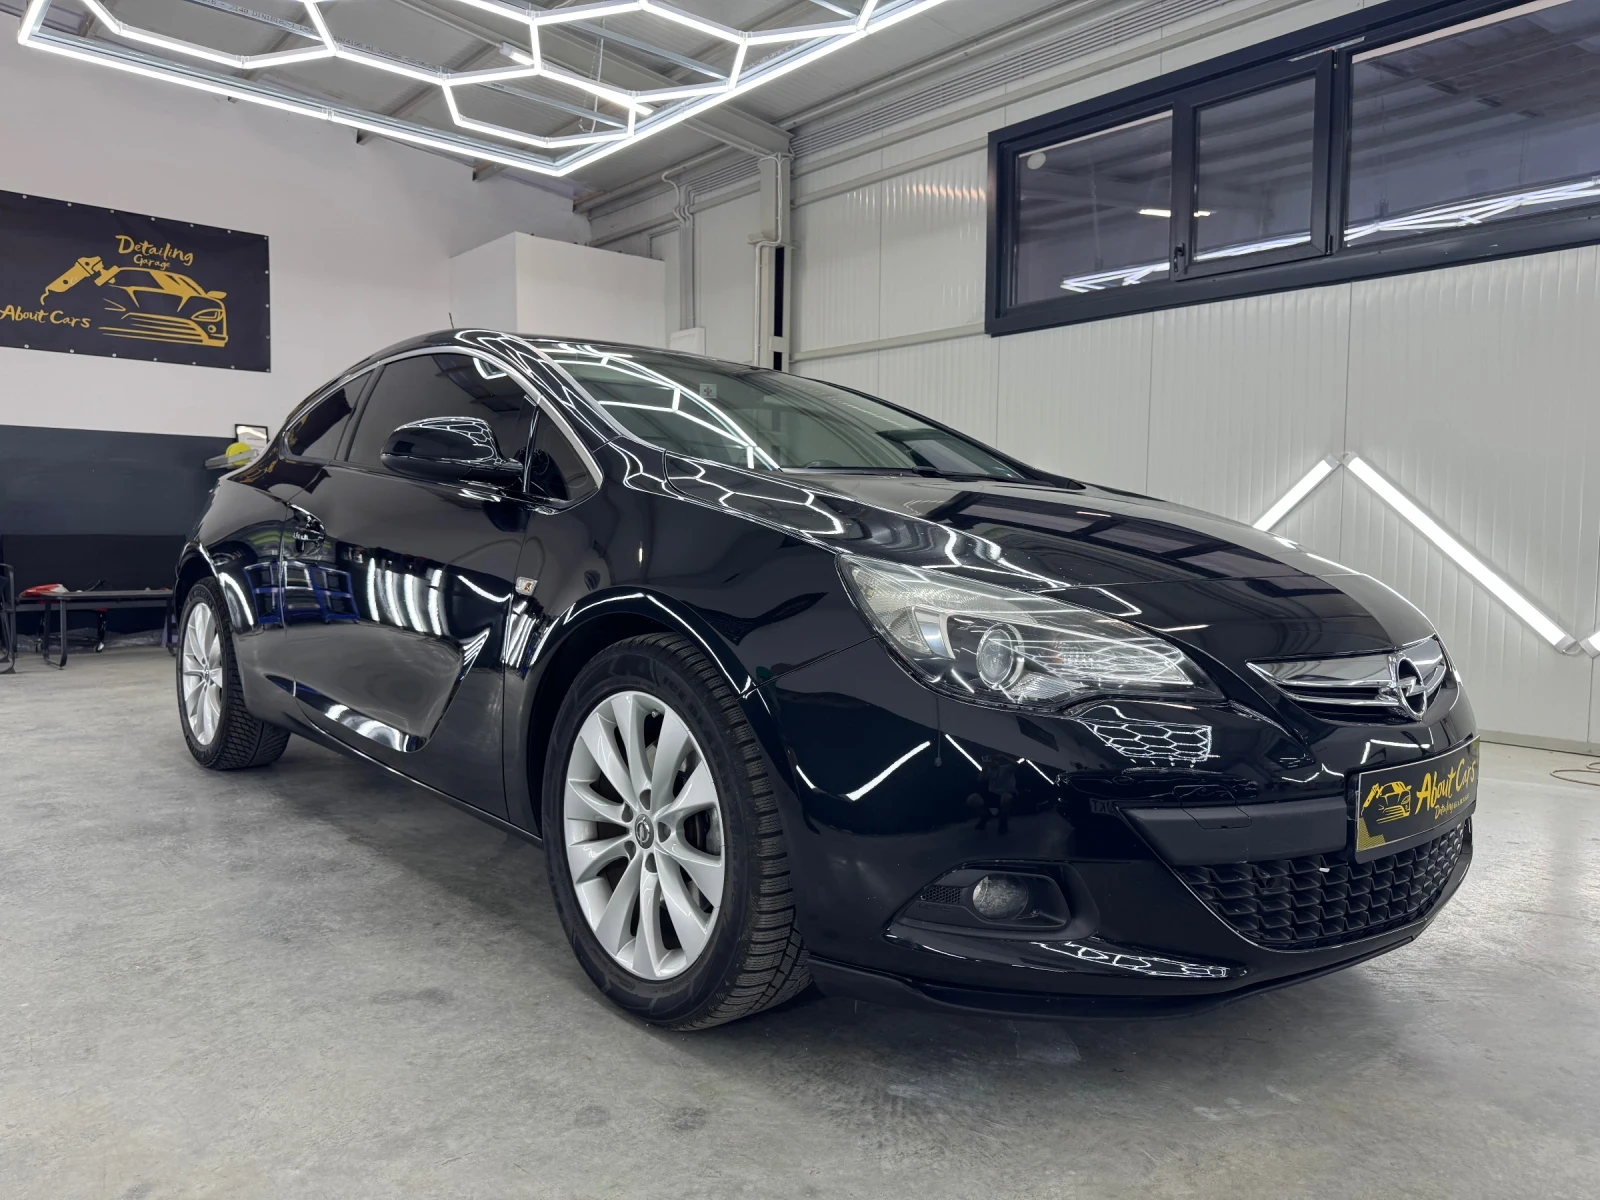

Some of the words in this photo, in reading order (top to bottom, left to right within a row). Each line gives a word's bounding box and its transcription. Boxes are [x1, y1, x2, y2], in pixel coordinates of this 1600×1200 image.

[115, 234, 194, 266] Detailing
[133, 254, 171, 270] Garage
[0, 304, 49, 323] About
[50, 310, 91, 328] Cars
[1415, 766, 1456, 815] About
[1455, 758, 1477, 792] Cars
